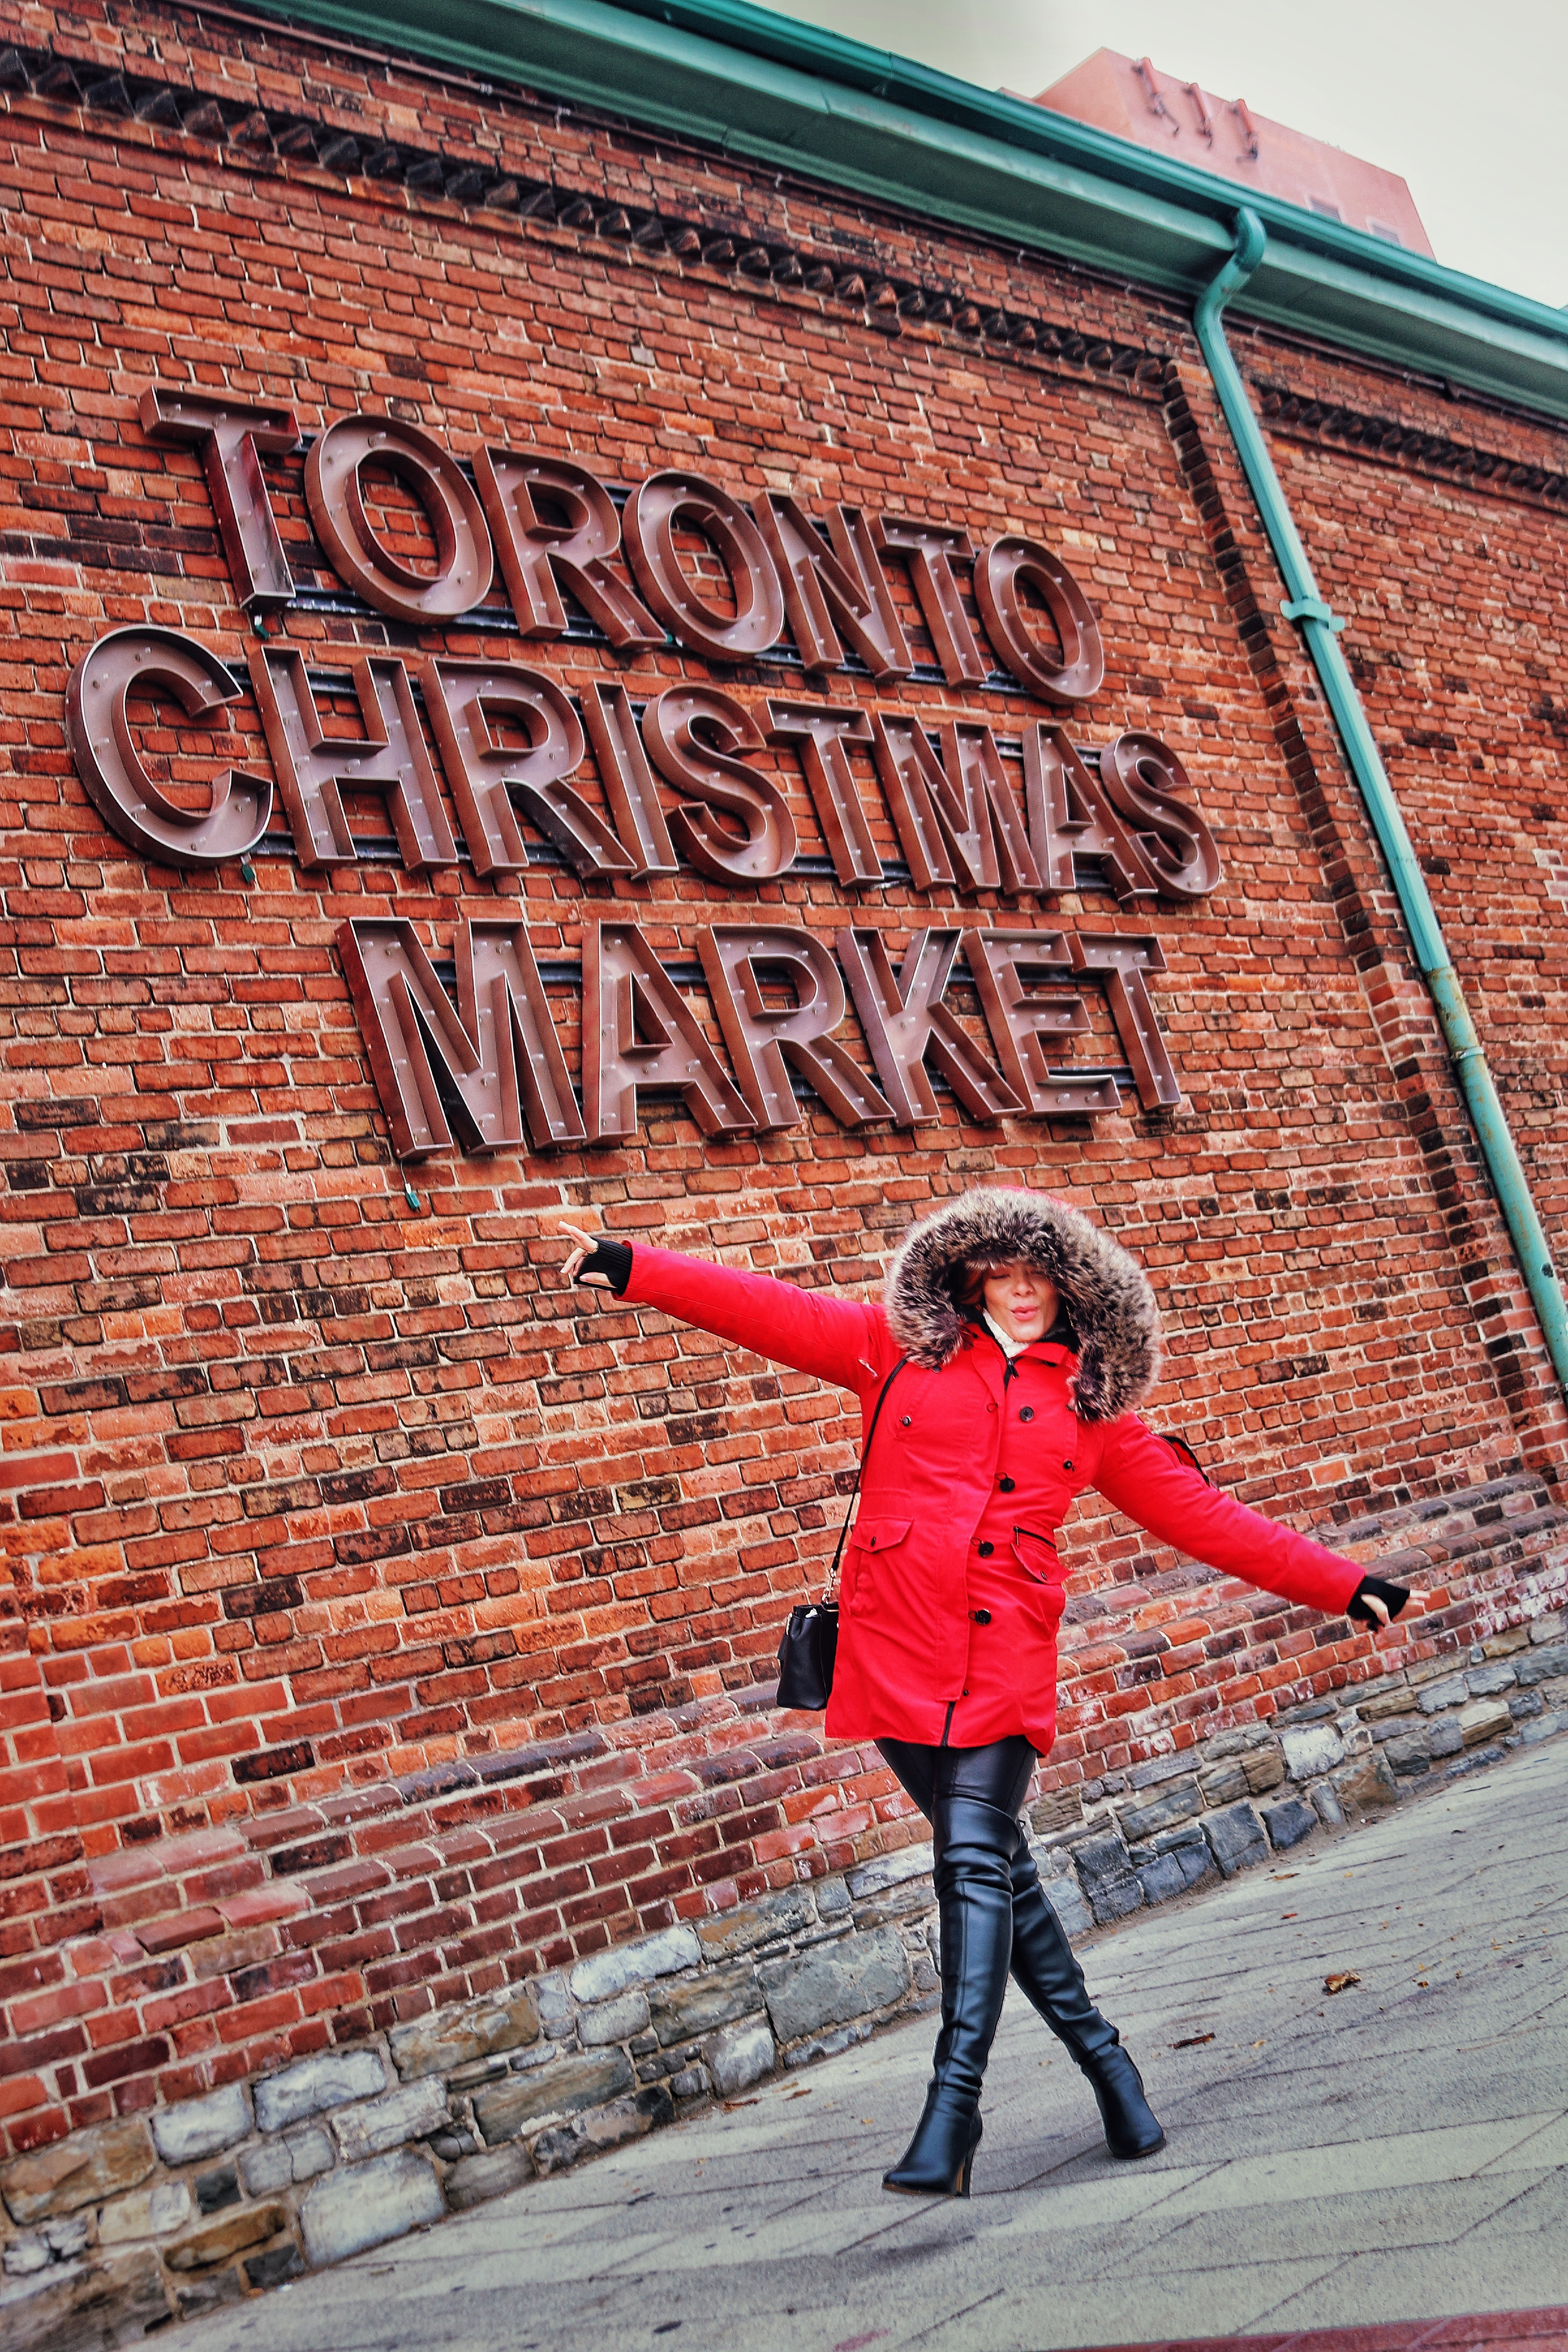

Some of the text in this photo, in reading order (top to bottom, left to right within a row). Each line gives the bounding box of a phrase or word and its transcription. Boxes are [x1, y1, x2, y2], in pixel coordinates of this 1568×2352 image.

[138, 386, 1104, 704] TORONTO
[65, 625, 1222, 900] CHRISTMAS
[336, 916, 1180, 1160] MARKET
